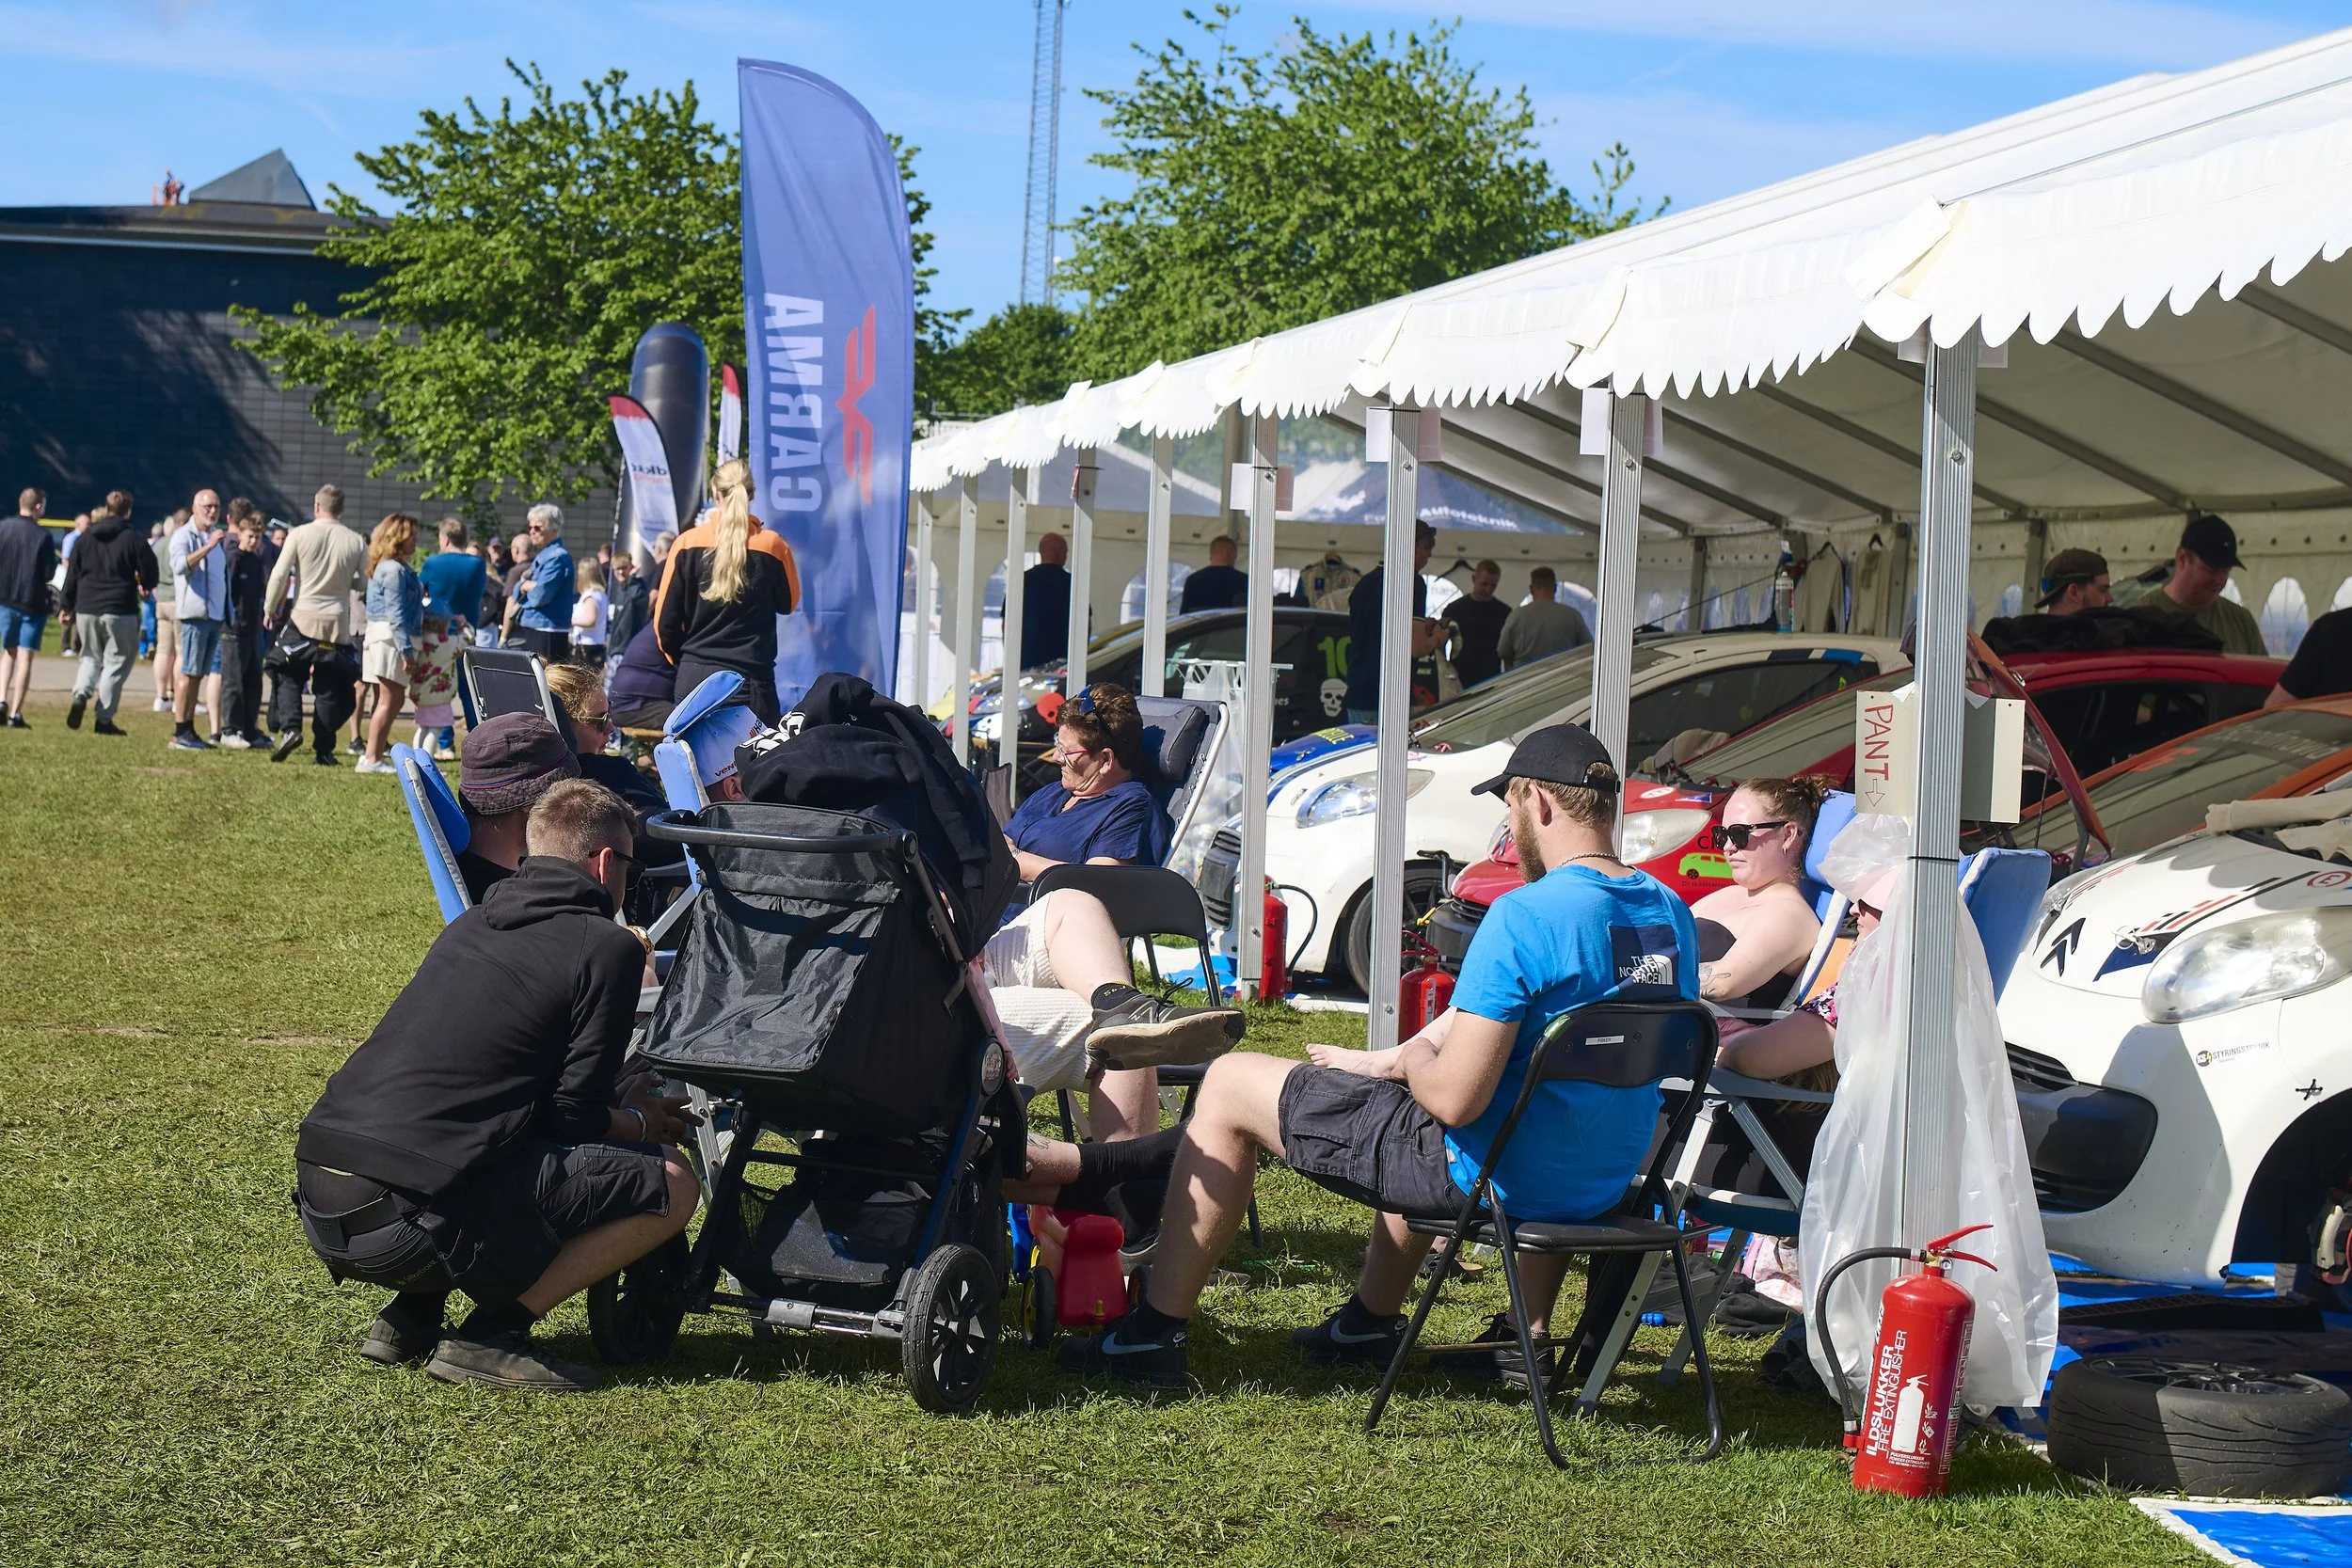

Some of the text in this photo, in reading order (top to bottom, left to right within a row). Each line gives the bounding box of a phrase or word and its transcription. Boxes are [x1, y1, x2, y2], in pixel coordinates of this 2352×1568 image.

[1865, 705, 1893, 781] PANT
[1619, 962, 1660, 977] NORTH
[1631, 955, 1653, 967] THE
[1636, 973, 1659, 985] FACE
[1866, 1344, 1894, 1456] ILDSLUKKER
[1878, 1329, 1908, 1451] FIRE EXTINGUISHER
